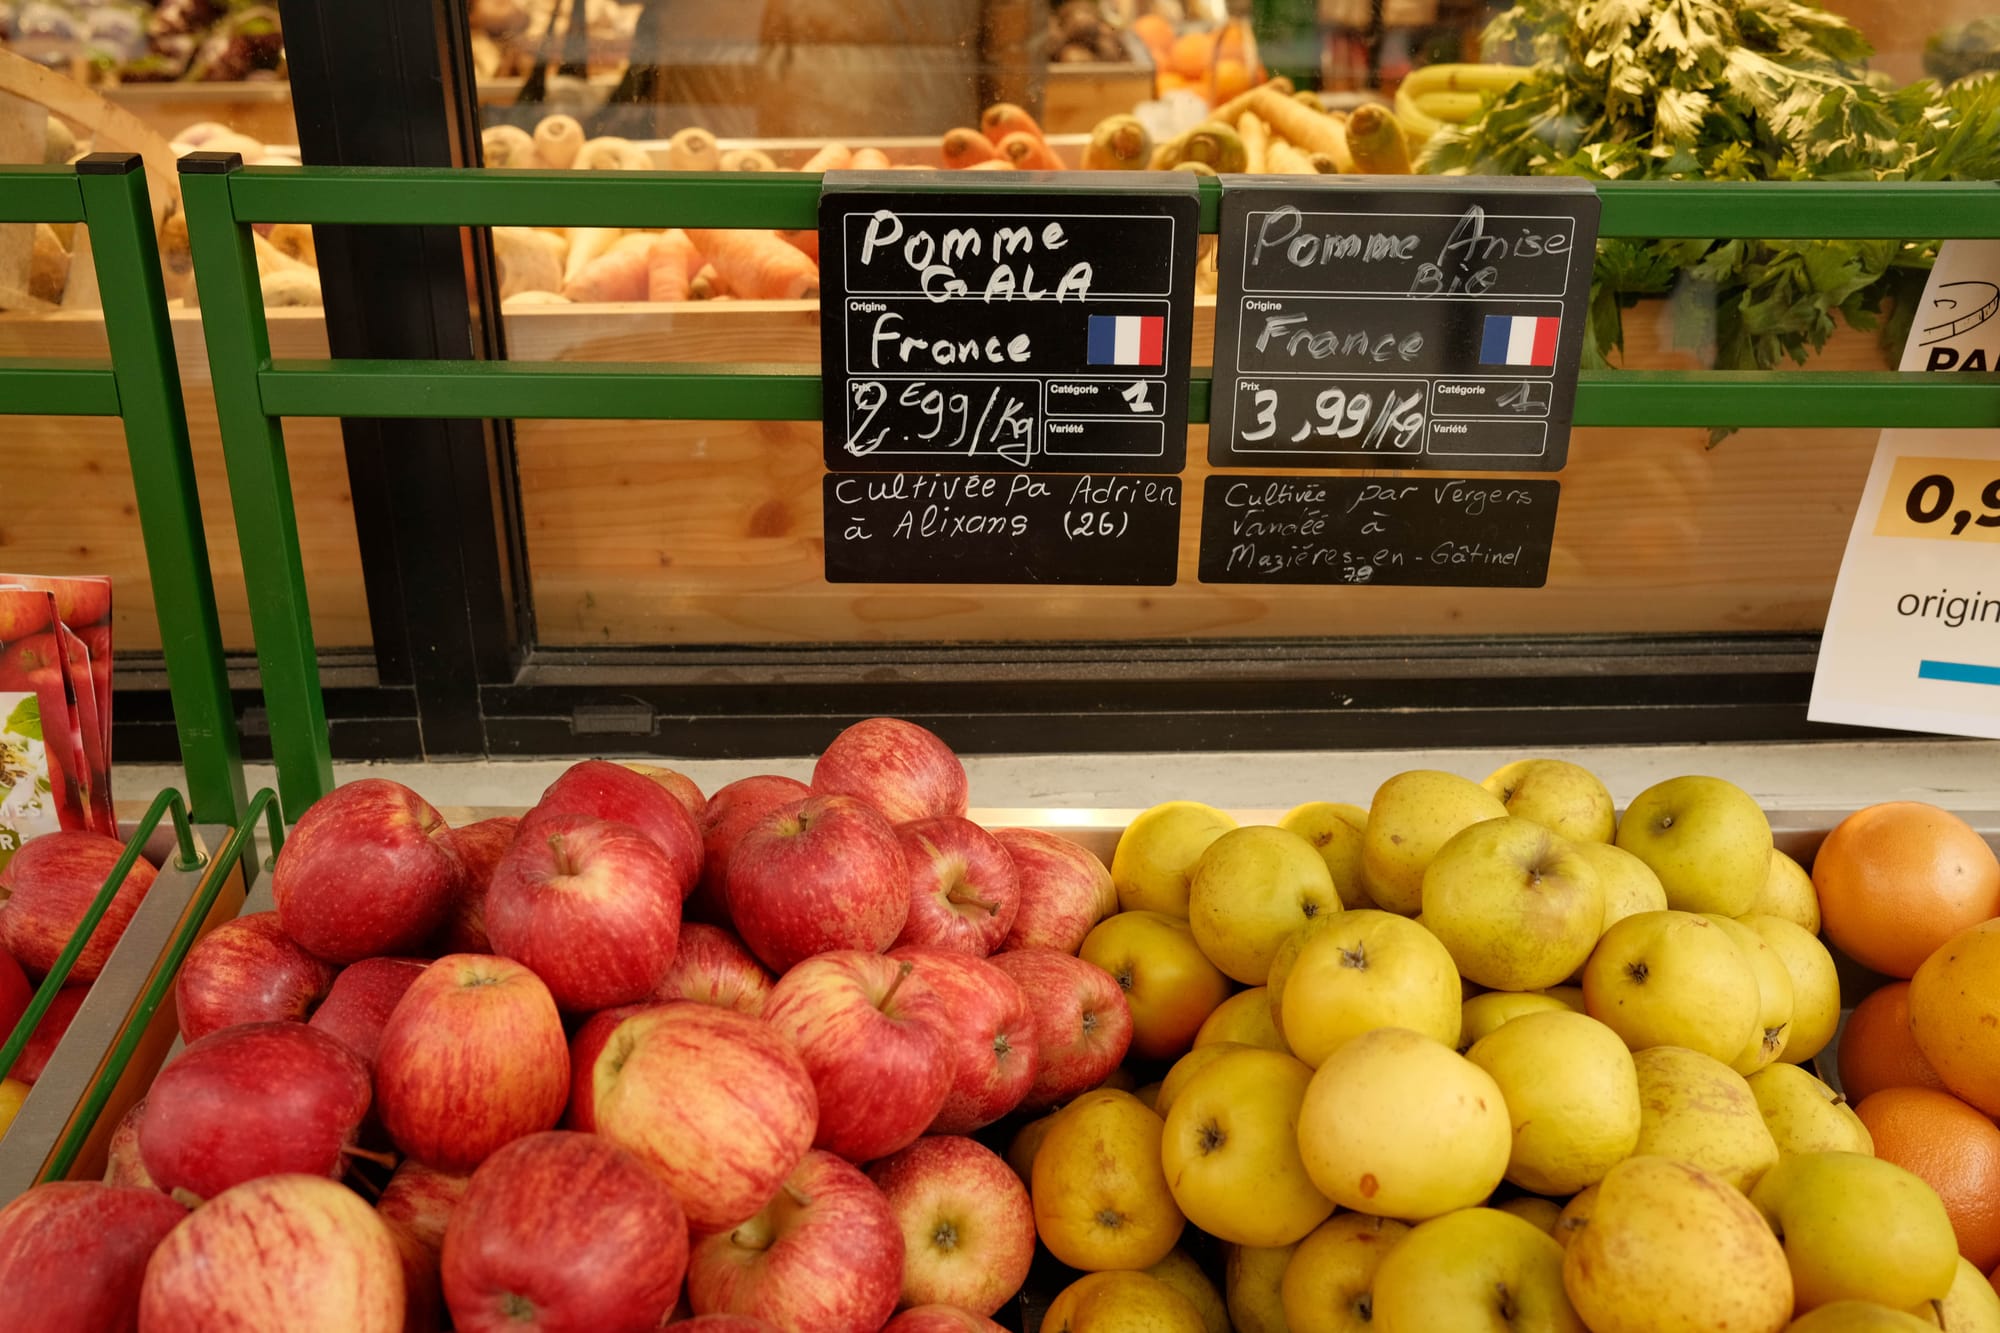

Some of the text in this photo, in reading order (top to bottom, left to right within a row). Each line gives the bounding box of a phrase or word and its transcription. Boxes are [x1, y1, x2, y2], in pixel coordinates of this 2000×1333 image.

[860, 210, 1068, 270] Pomme
[1251, 204, 1574, 268] Pomme Anise
[920, 261, 1093, 303] GALA
[849, 301, 887, 313] Origine
[1245, 300, 1282, 313] Origine
[1255, 312, 1424, 362] France
[1926, 347, 2000, 372] PA
[1049, 379, 1154, 413] Catégorie 1
[1240, 381, 1260, 392] Prix
[1437, 384, 1486, 396] Catégorie
[1049, 424, 1084, 434] Variété
[1433, 424, 1468, 434] Variété
[1069, 475, 1176, 506] Adrien
[1434, 480, 1532, 515] Vergers
[893, 505, 1028, 538] Alixans
